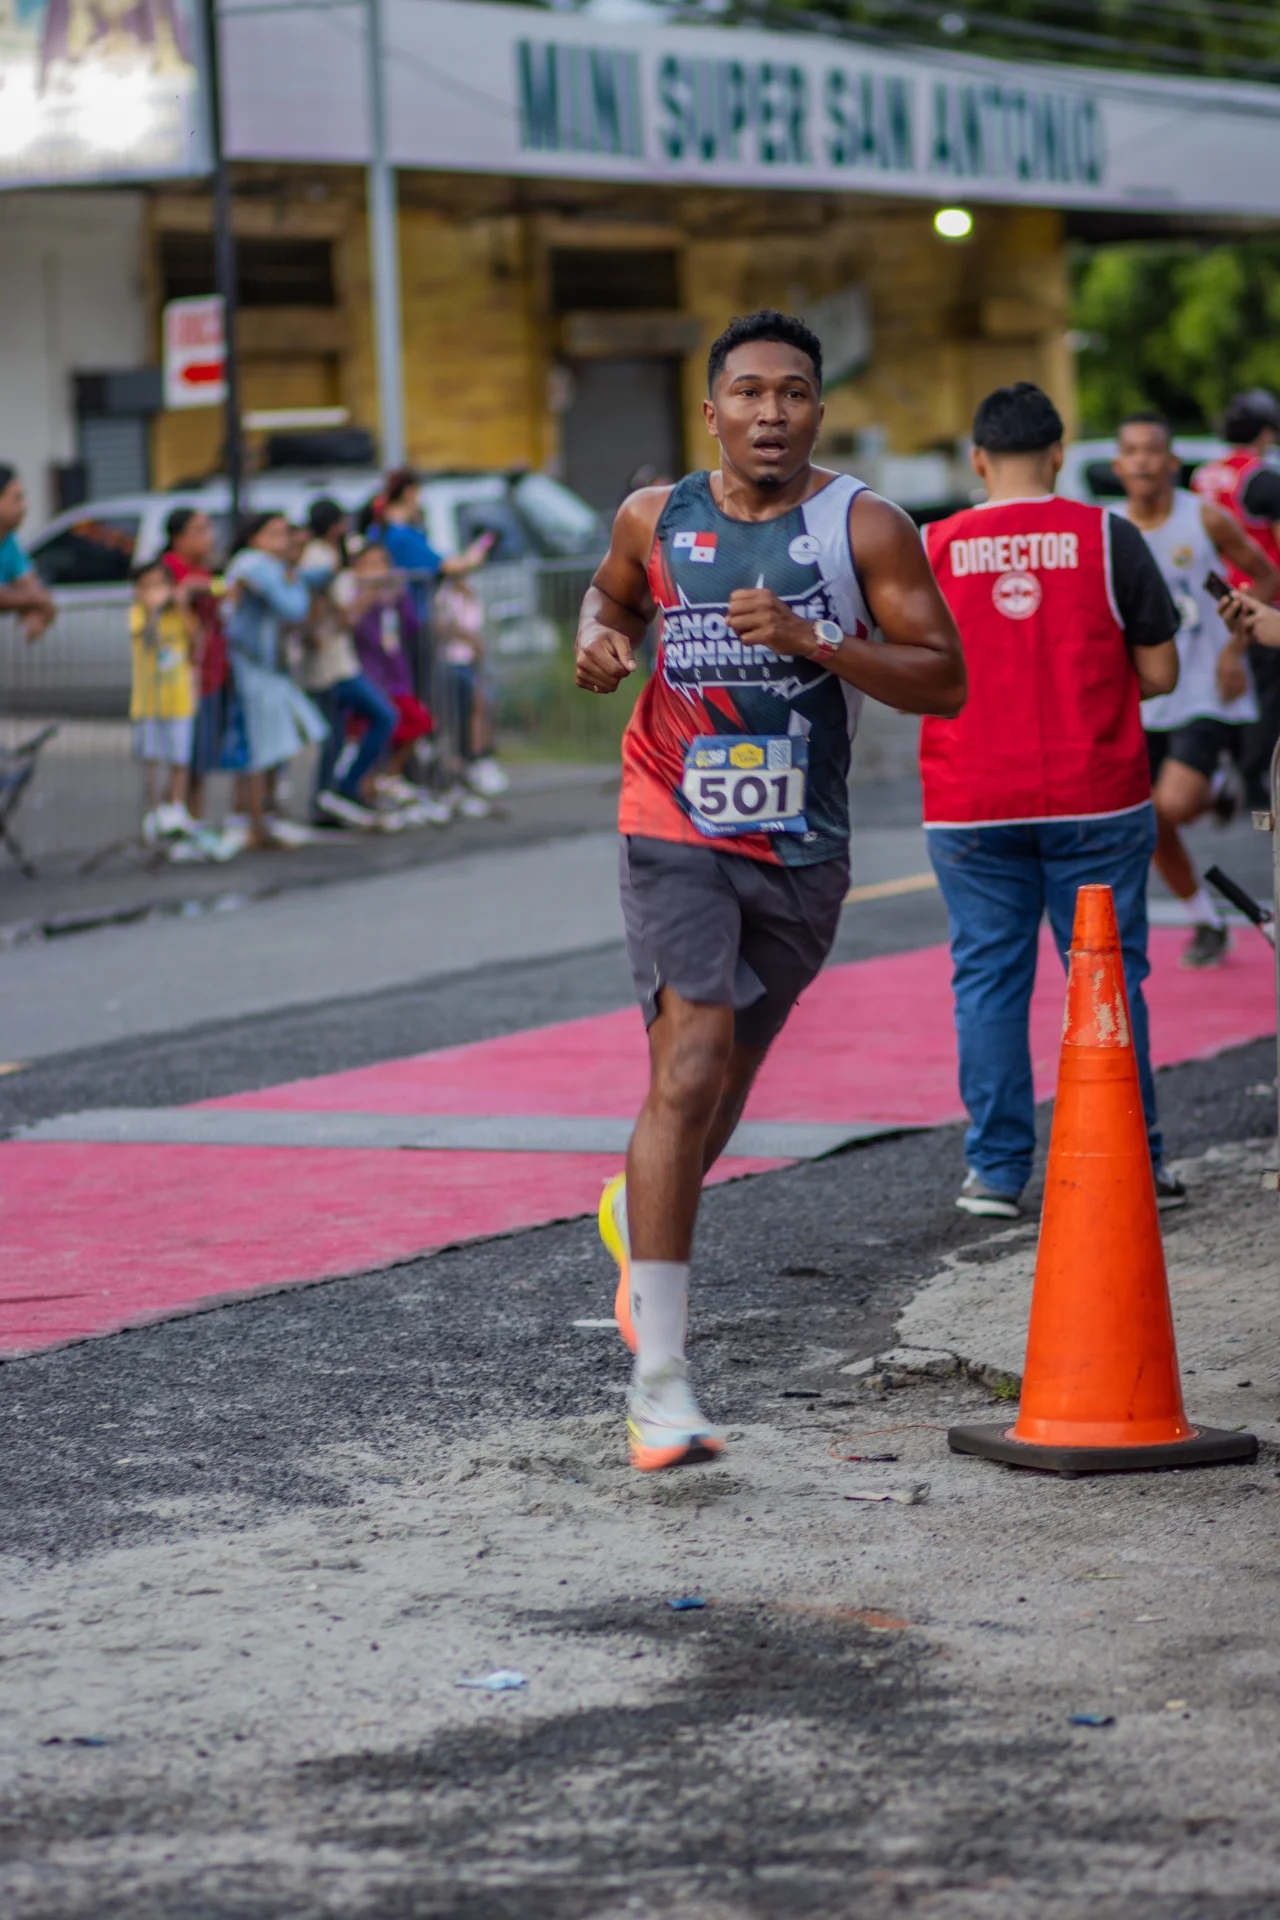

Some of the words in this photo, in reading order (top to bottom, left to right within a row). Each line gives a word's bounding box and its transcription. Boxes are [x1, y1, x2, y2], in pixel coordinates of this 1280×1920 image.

[517, 38, 642, 158] MINI
[658, 53, 812, 165] SUPER
[824, 66, 913, 170] SAN
[929, 80, 1106, 185] ANTONIO
[950, 532, 1079, 577] DIRECTOR
[699, 775, 789, 816] 501
